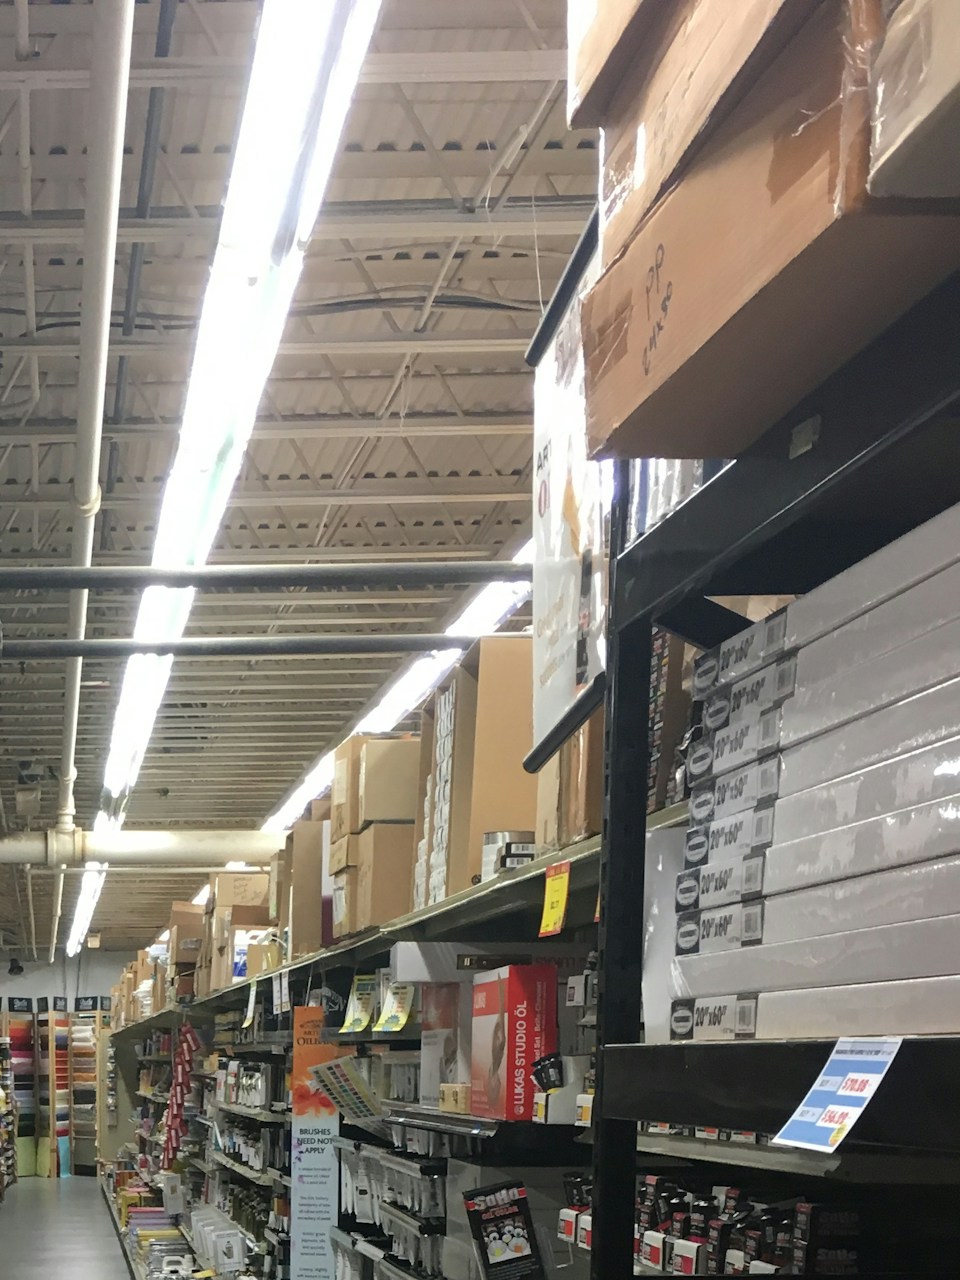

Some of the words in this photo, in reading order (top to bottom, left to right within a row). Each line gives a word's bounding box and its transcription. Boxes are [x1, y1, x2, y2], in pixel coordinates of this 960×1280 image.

[711, 820, 744, 849] 20"x60"
[701, 867, 733, 894] 20"x60"
[701, 914, 733, 939] 20"x60"
[513, 1000, 527, 1017] ÖL
[695, 1005, 727, 1026] 20"x60"
[515, 1019, 527, 1066] STUDIO
[513, 1068, 527, 1105] LUKAS
[297, 1137, 316, 1146] NEED
[299, 1128, 332, 1136] BRUSHES
[303, 1147, 326, 1155] APPLY
